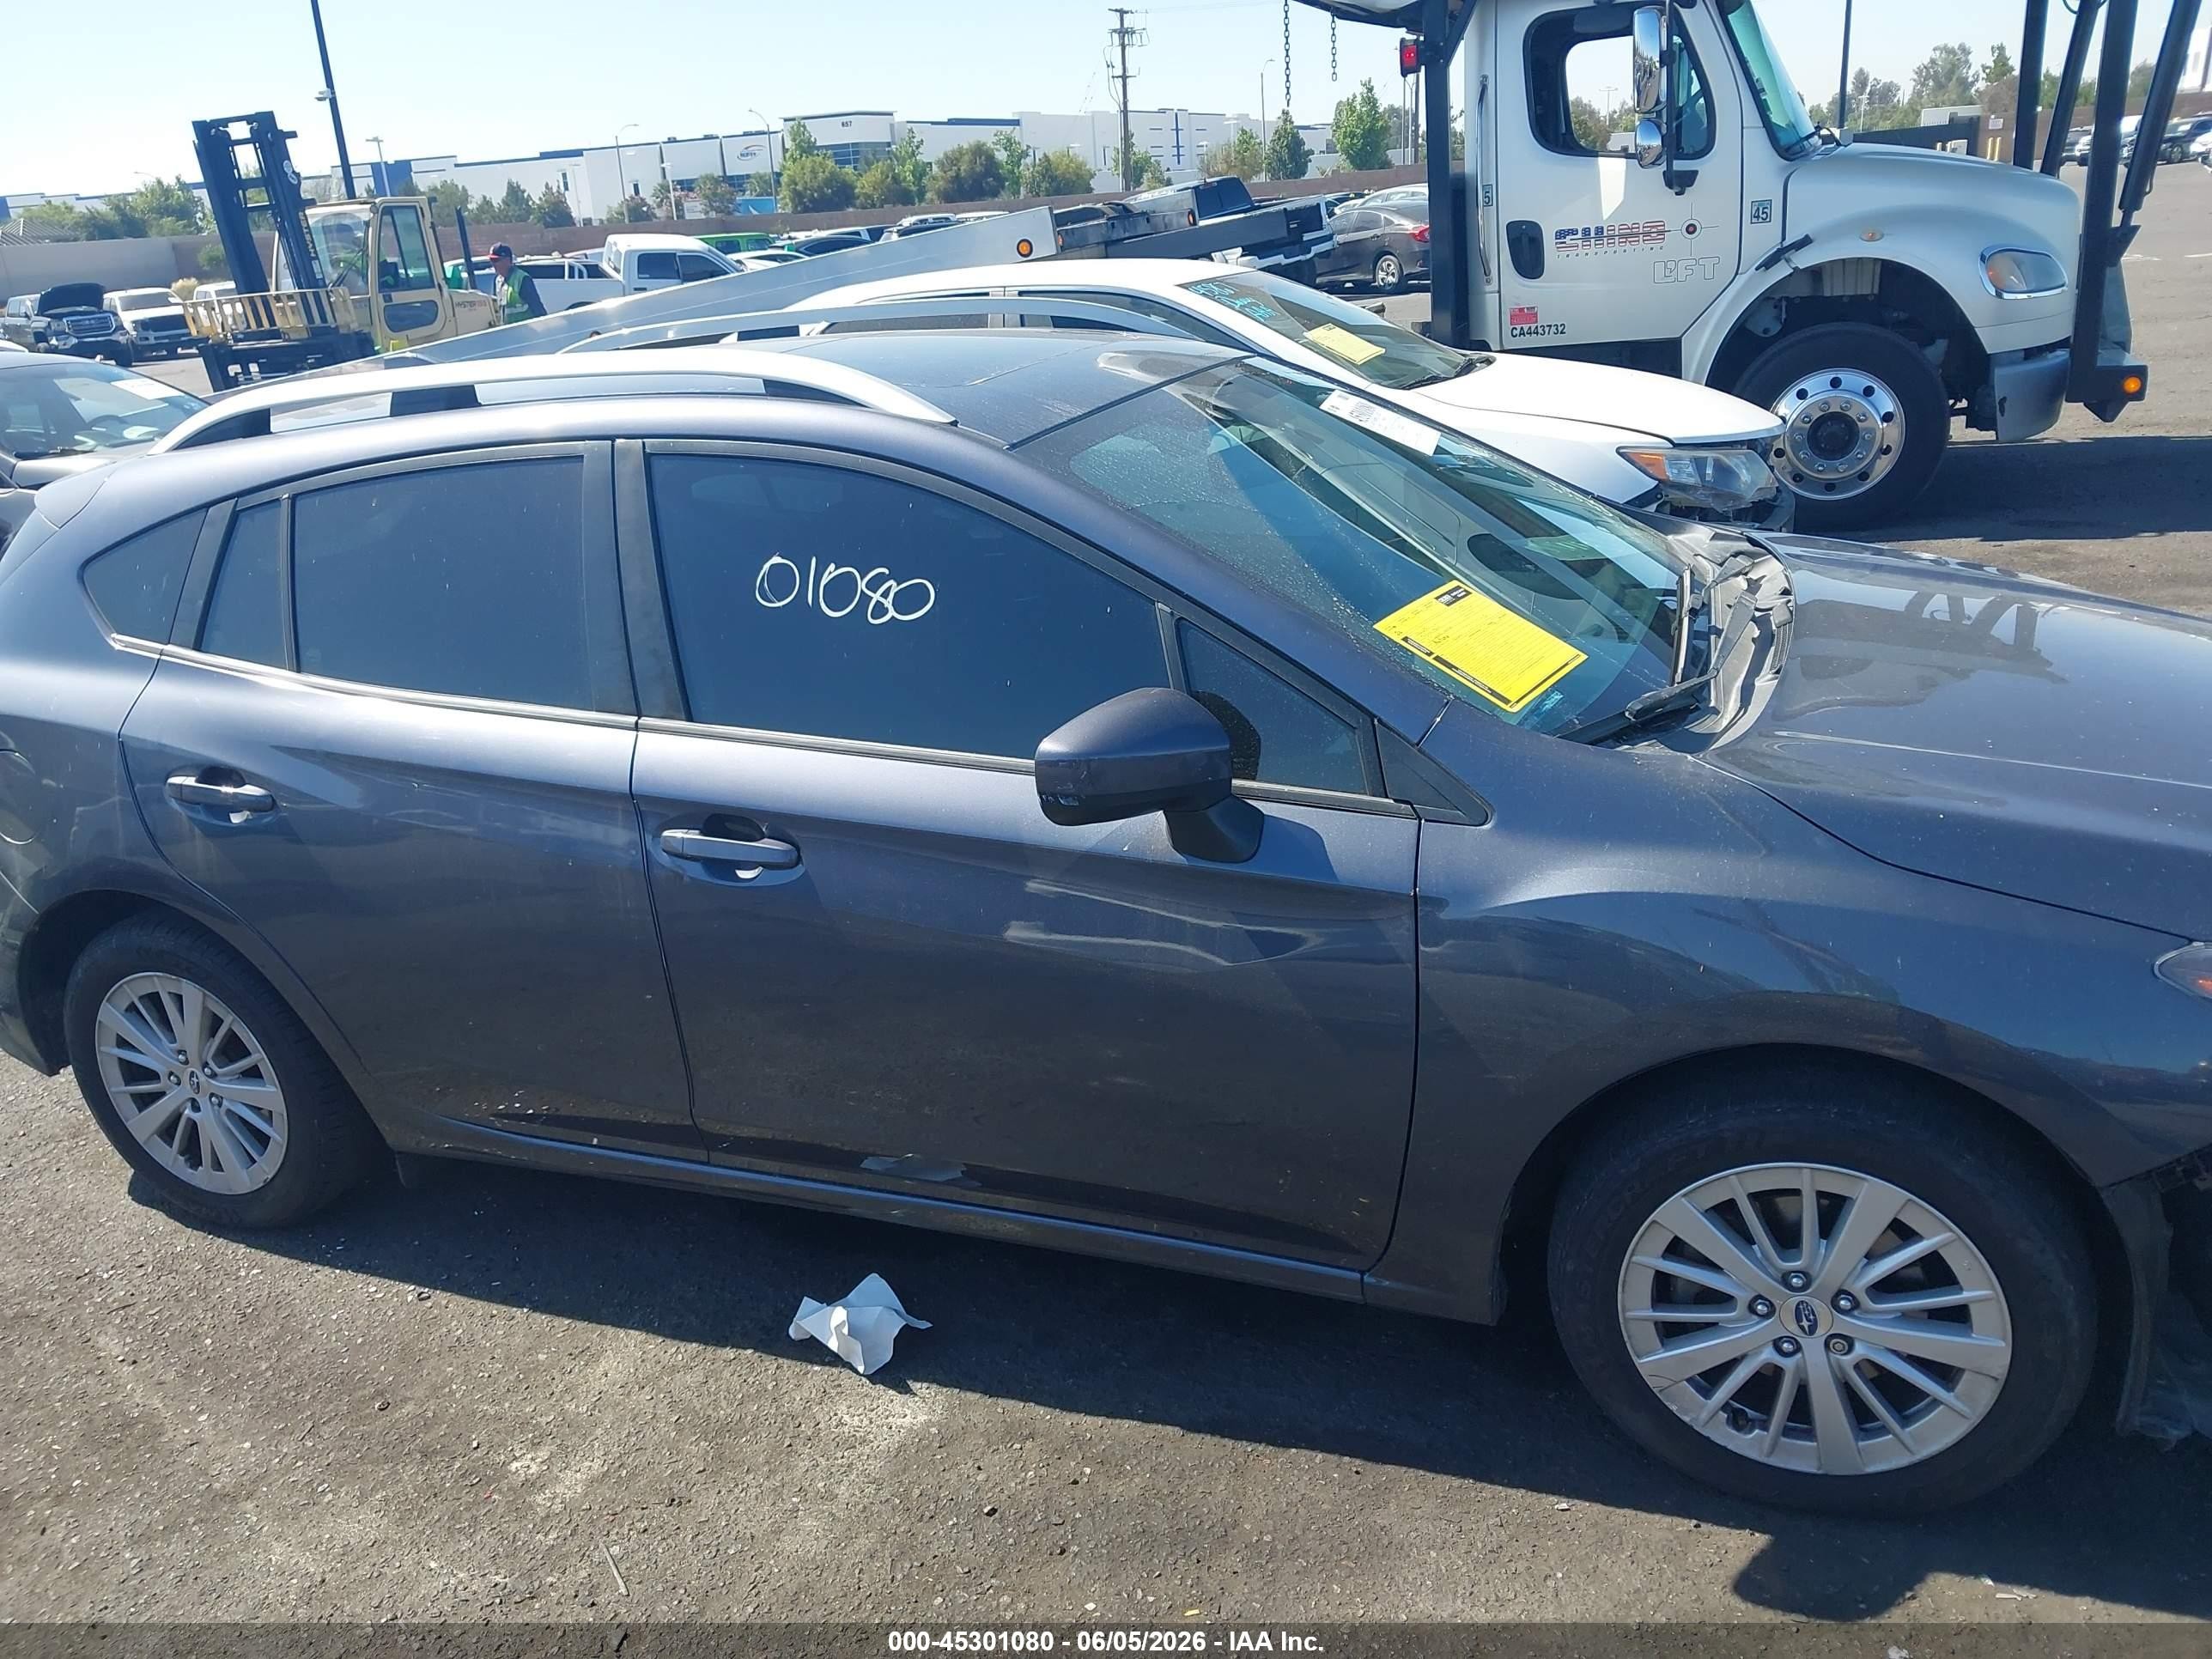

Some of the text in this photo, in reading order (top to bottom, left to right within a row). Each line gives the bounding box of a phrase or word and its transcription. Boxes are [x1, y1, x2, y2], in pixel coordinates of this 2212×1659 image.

[1753, 206, 1769, 222] 45
[1510, 323, 1566, 338] CA443732
[756, 555, 936, 625] 01080
